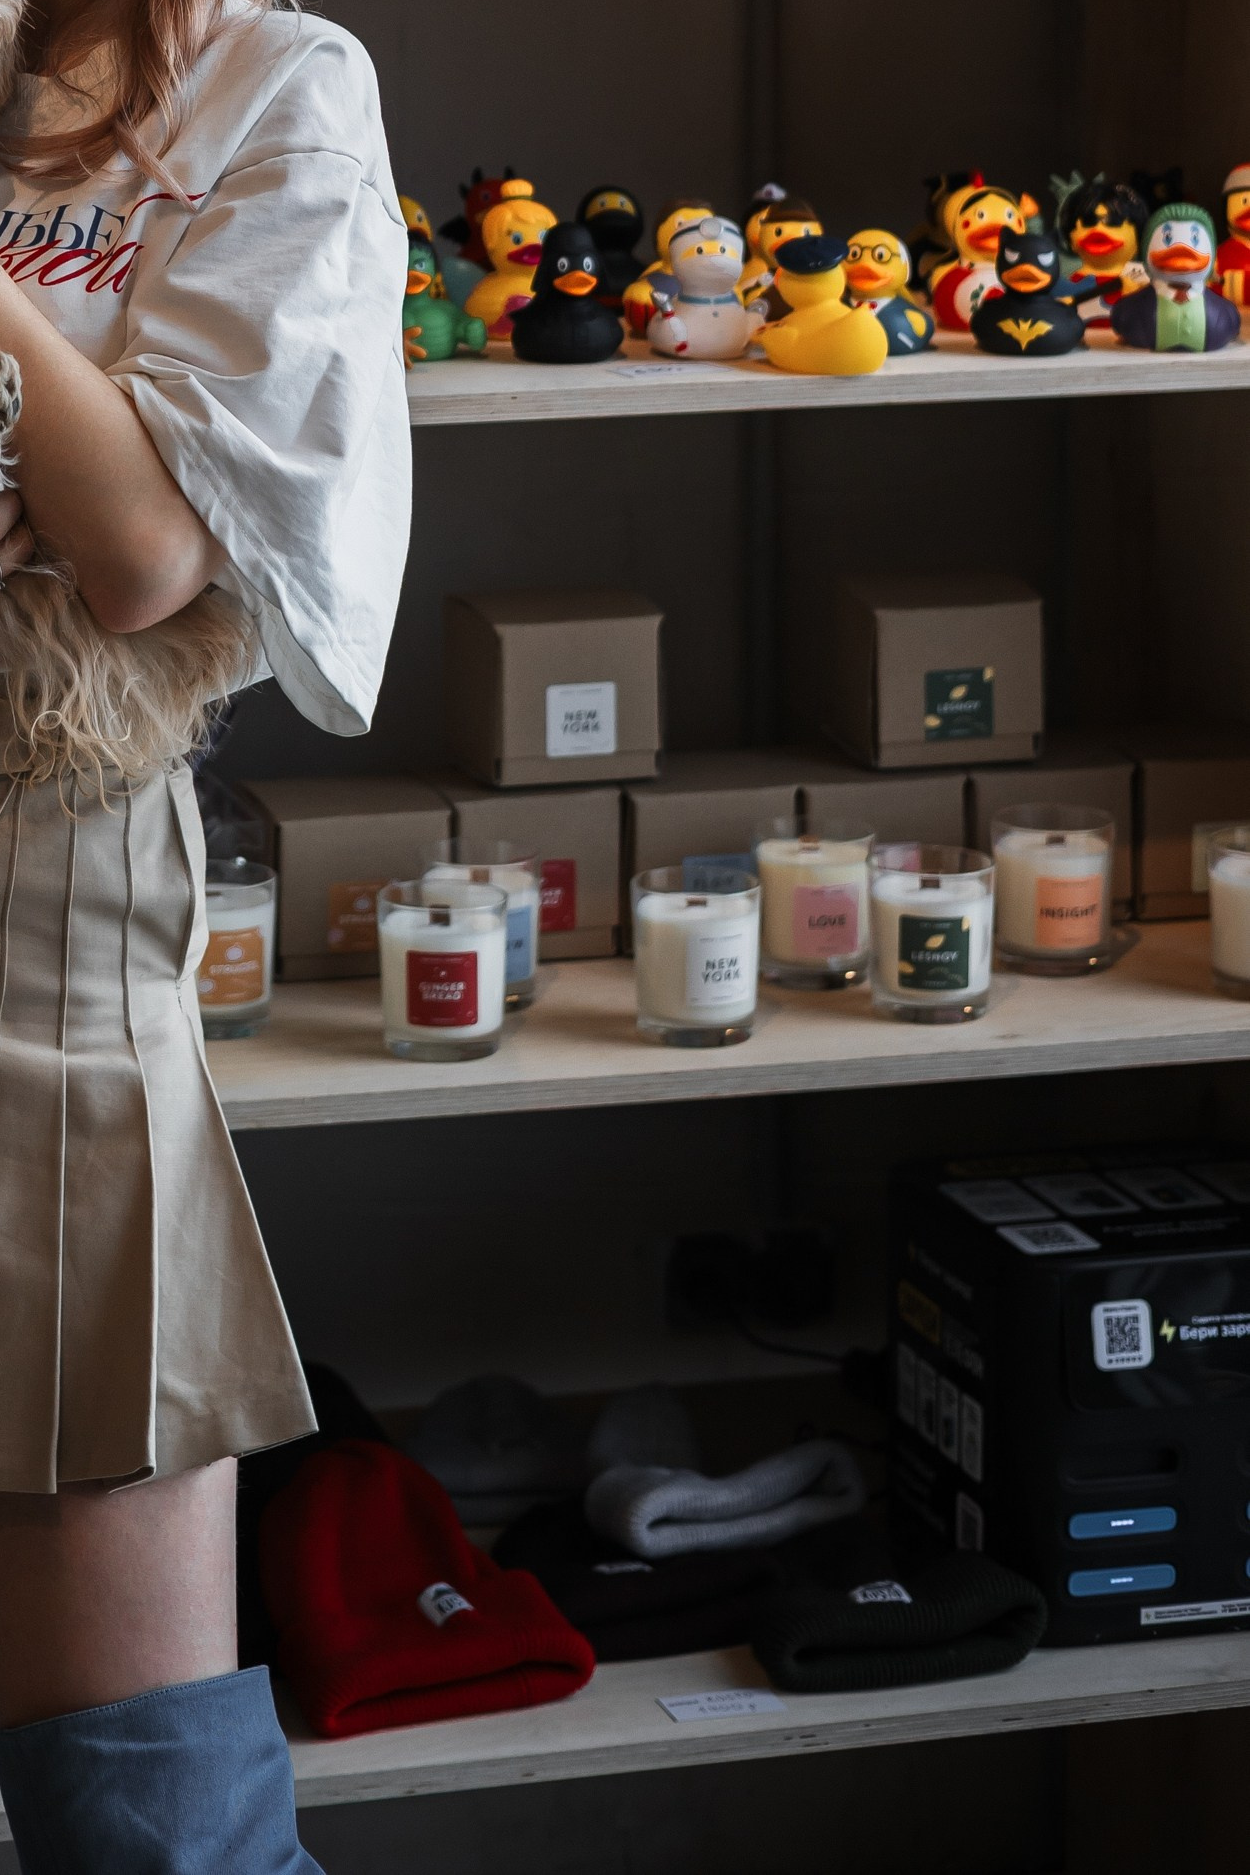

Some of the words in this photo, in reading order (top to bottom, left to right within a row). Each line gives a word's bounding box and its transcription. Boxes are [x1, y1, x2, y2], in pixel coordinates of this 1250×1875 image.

[564, 710, 597, 722] NEW
[563, 722, 599, 734] YORK
[1040, 903, 1097, 919] INSIGHT
[807, 913, 847, 929] LOVE
[704, 957, 738, 971] NEW
[910, 950, 957, 964] LESNOY
[701, 970, 740, 983] YORK
[1180, 1325, 1218, 1341] Бери
